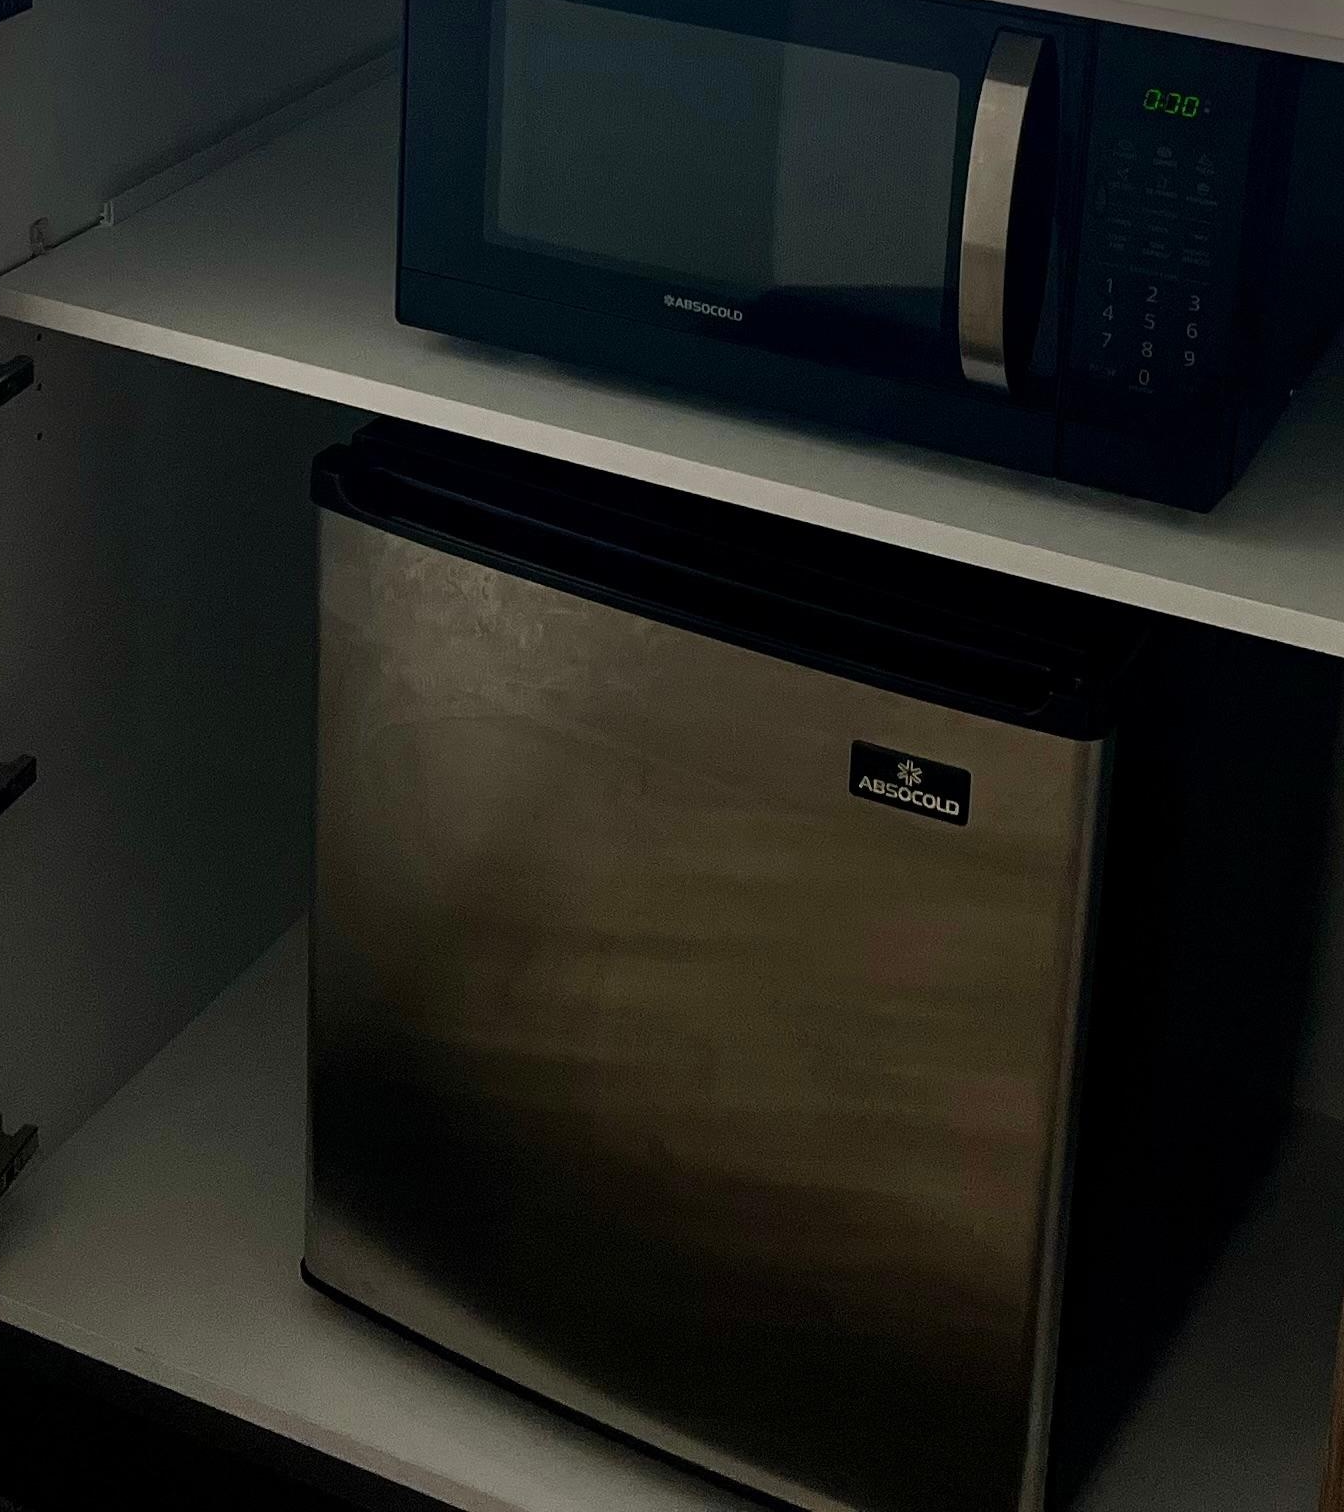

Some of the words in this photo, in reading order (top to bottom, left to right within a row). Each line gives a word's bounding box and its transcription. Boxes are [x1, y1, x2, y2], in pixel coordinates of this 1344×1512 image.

[674, 297, 743, 322] ABSOCOLD
[1106, 277, 1113, 294] 1
[1146, 286, 1158, 303] 2
[1188, 295, 1201, 312] 3
[1102, 304, 1114, 321] 4
[1144, 313, 1156, 330] 5
[1186, 322, 1198, 339] 6
[1102, 331, 1112, 348] 7
[1141, 341, 1153, 358] 8
[1184, 350, 1195, 367] 9
[1138, 369, 1150, 386] 0
[858, 775, 960, 816] ABSOCOLD
